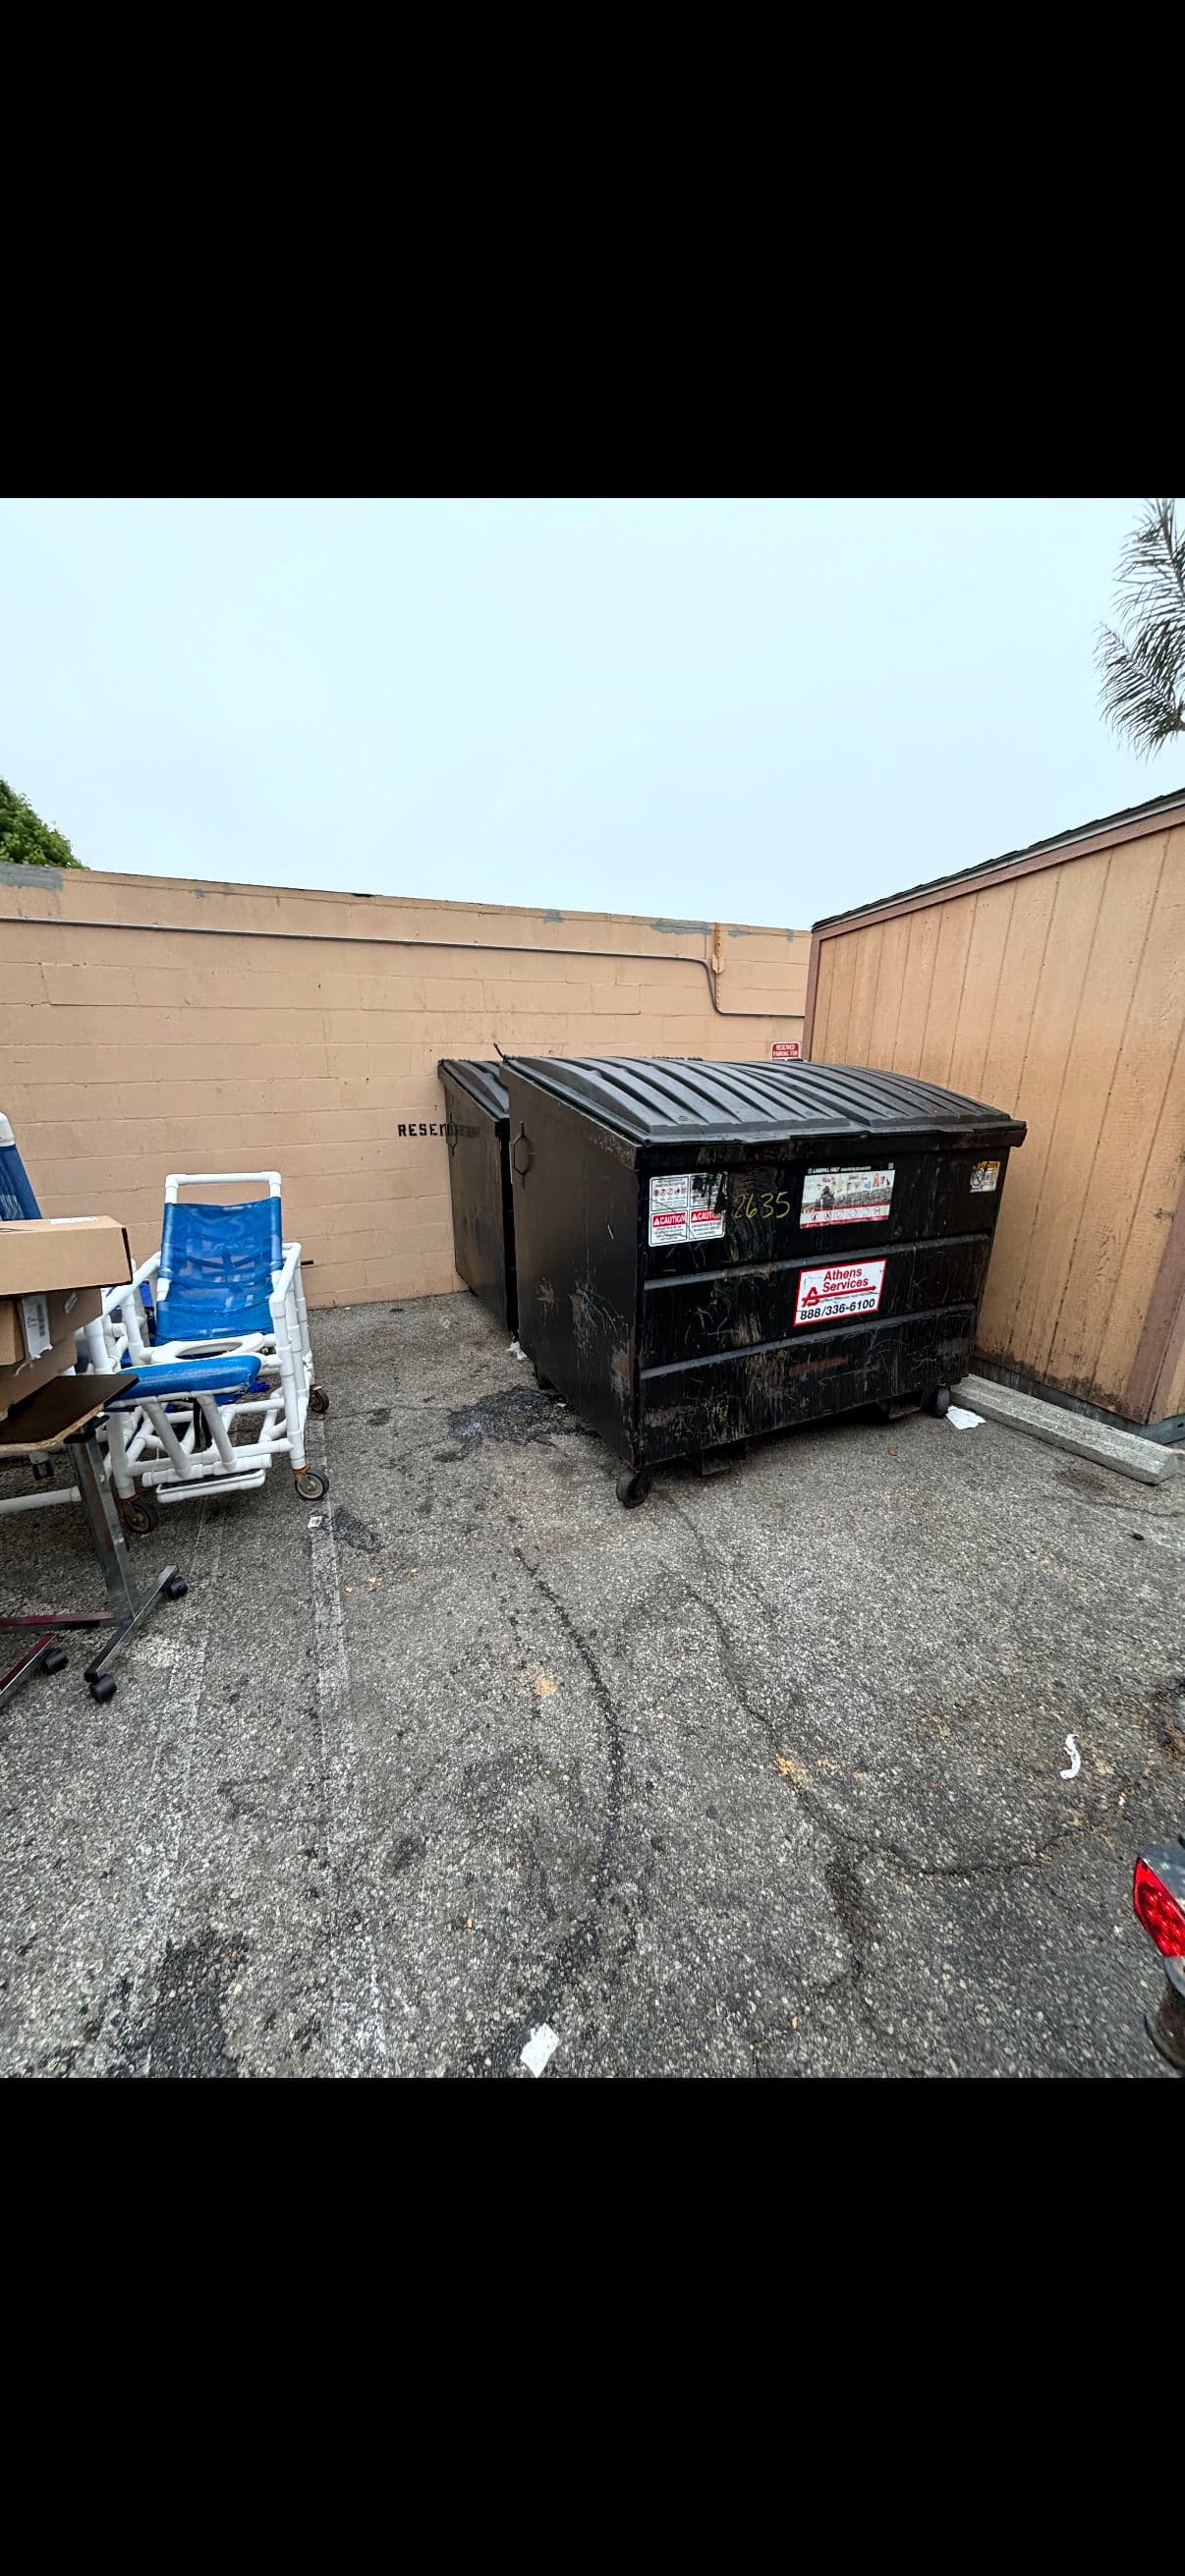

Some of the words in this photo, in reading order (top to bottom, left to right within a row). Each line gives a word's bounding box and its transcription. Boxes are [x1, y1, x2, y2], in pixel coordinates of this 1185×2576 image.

[734, 1191, 790, 1219] 2635
[659, 1214, 686, 1225] CAUTION
[698, 1210, 722, 1221] CAUTI
[823, 1267, 863, 1281] Athens
[822, 1277, 869, 1293] Services
[800, 1298, 875, 1320] 888/336-6100
